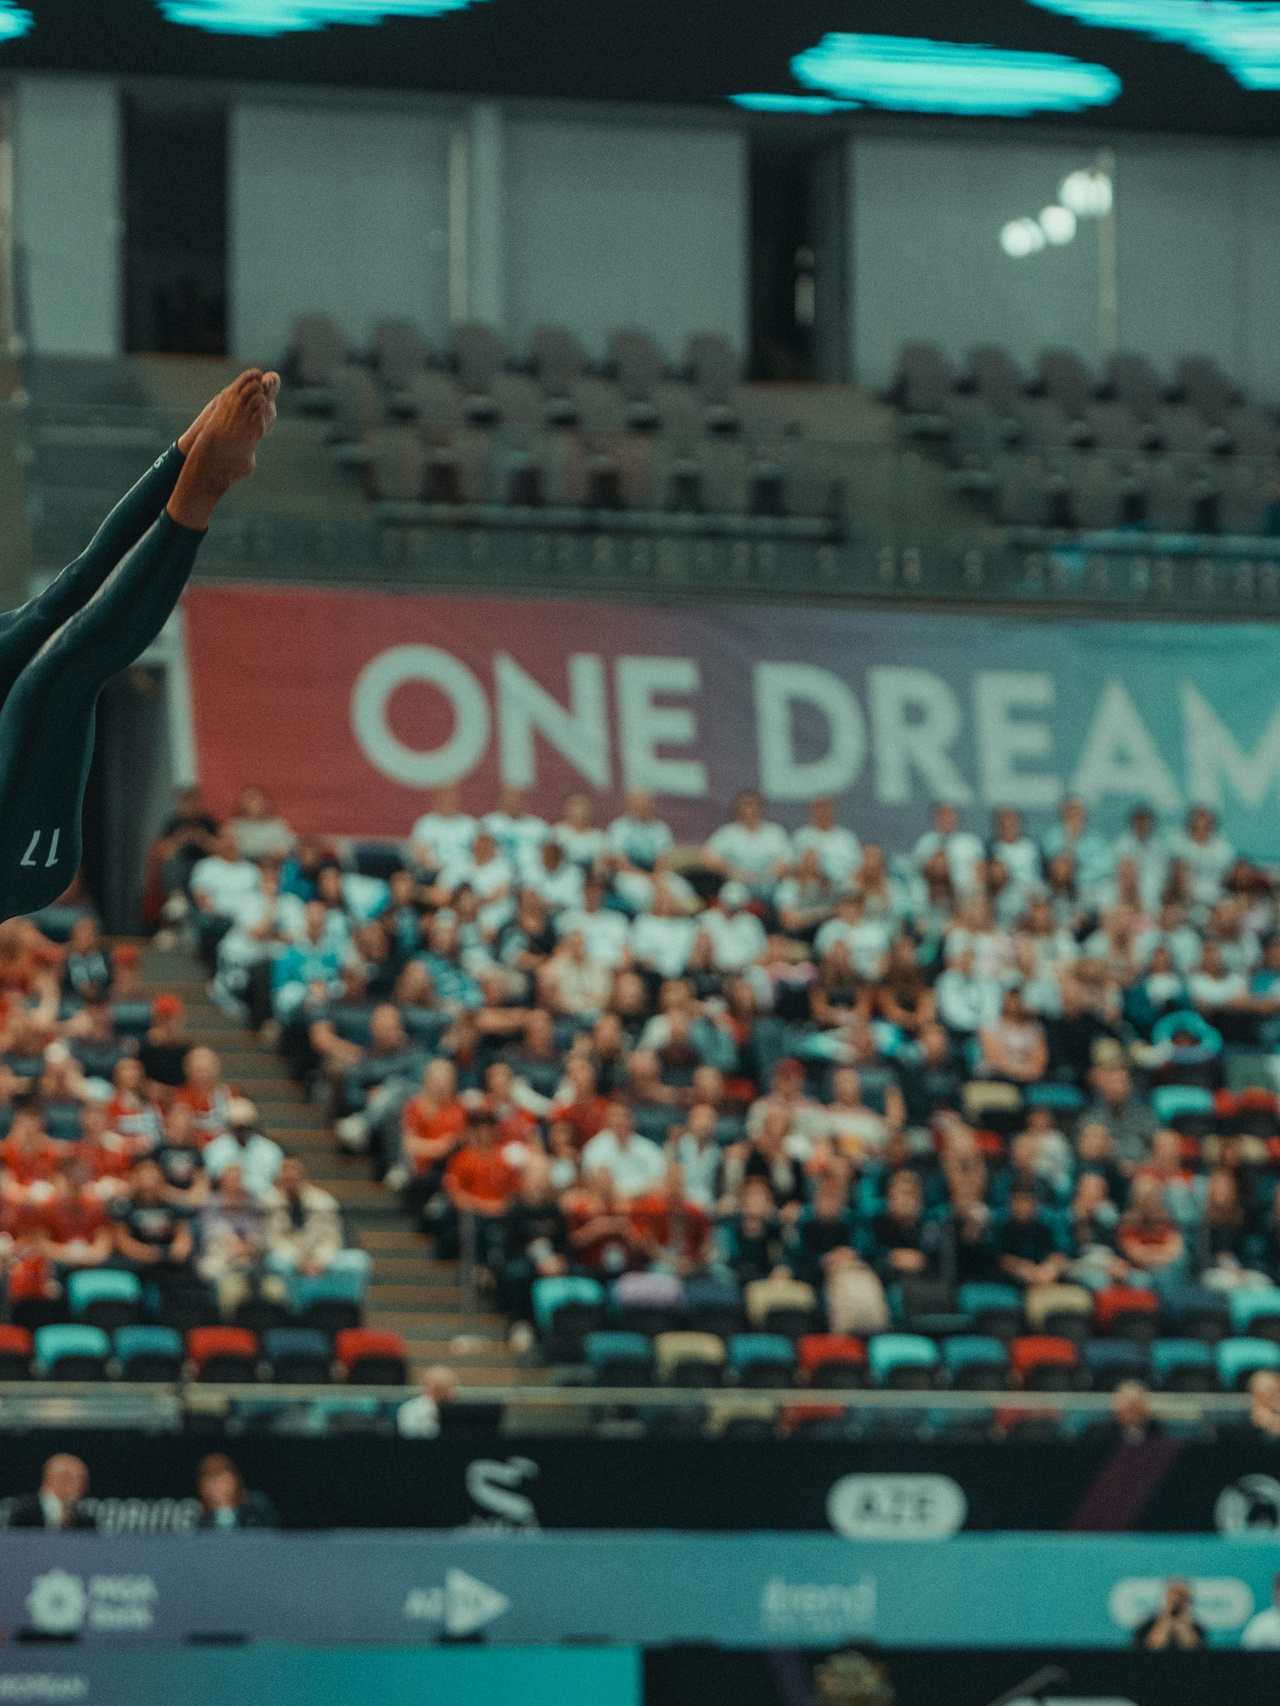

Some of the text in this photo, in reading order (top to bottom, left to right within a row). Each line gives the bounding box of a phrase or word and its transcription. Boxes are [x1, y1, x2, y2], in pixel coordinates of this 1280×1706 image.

[350, 643, 1280, 806] ONE DREAM
[20, 828, 60, 867] 17
